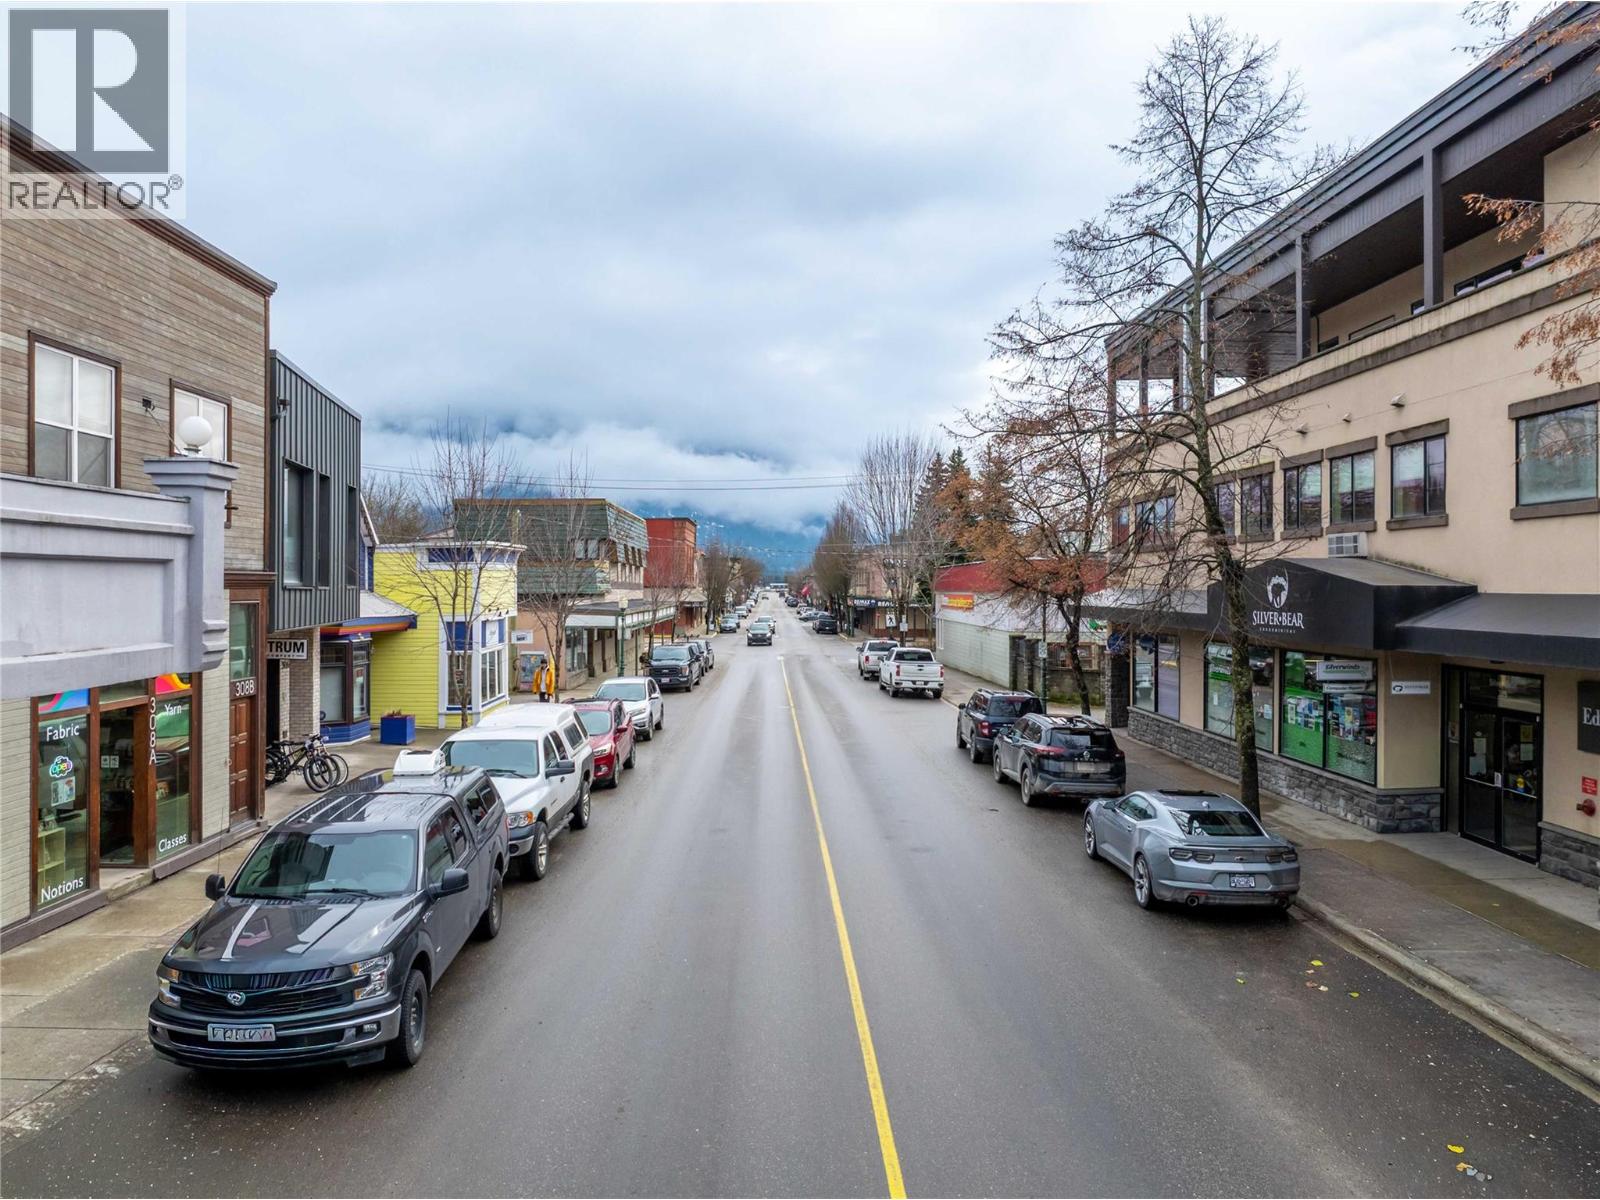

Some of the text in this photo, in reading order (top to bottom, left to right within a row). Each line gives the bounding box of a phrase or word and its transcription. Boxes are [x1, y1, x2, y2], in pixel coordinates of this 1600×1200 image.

[267, 640, 304, 653] TRUM
[235, 679, 255, 697] 308B
[164, 703, 182, 716] Yarn
[46, 723, 80, 742] Fabric
[158, 832, 187, 853] Classes
[41, 875, 84, 903] Notions
